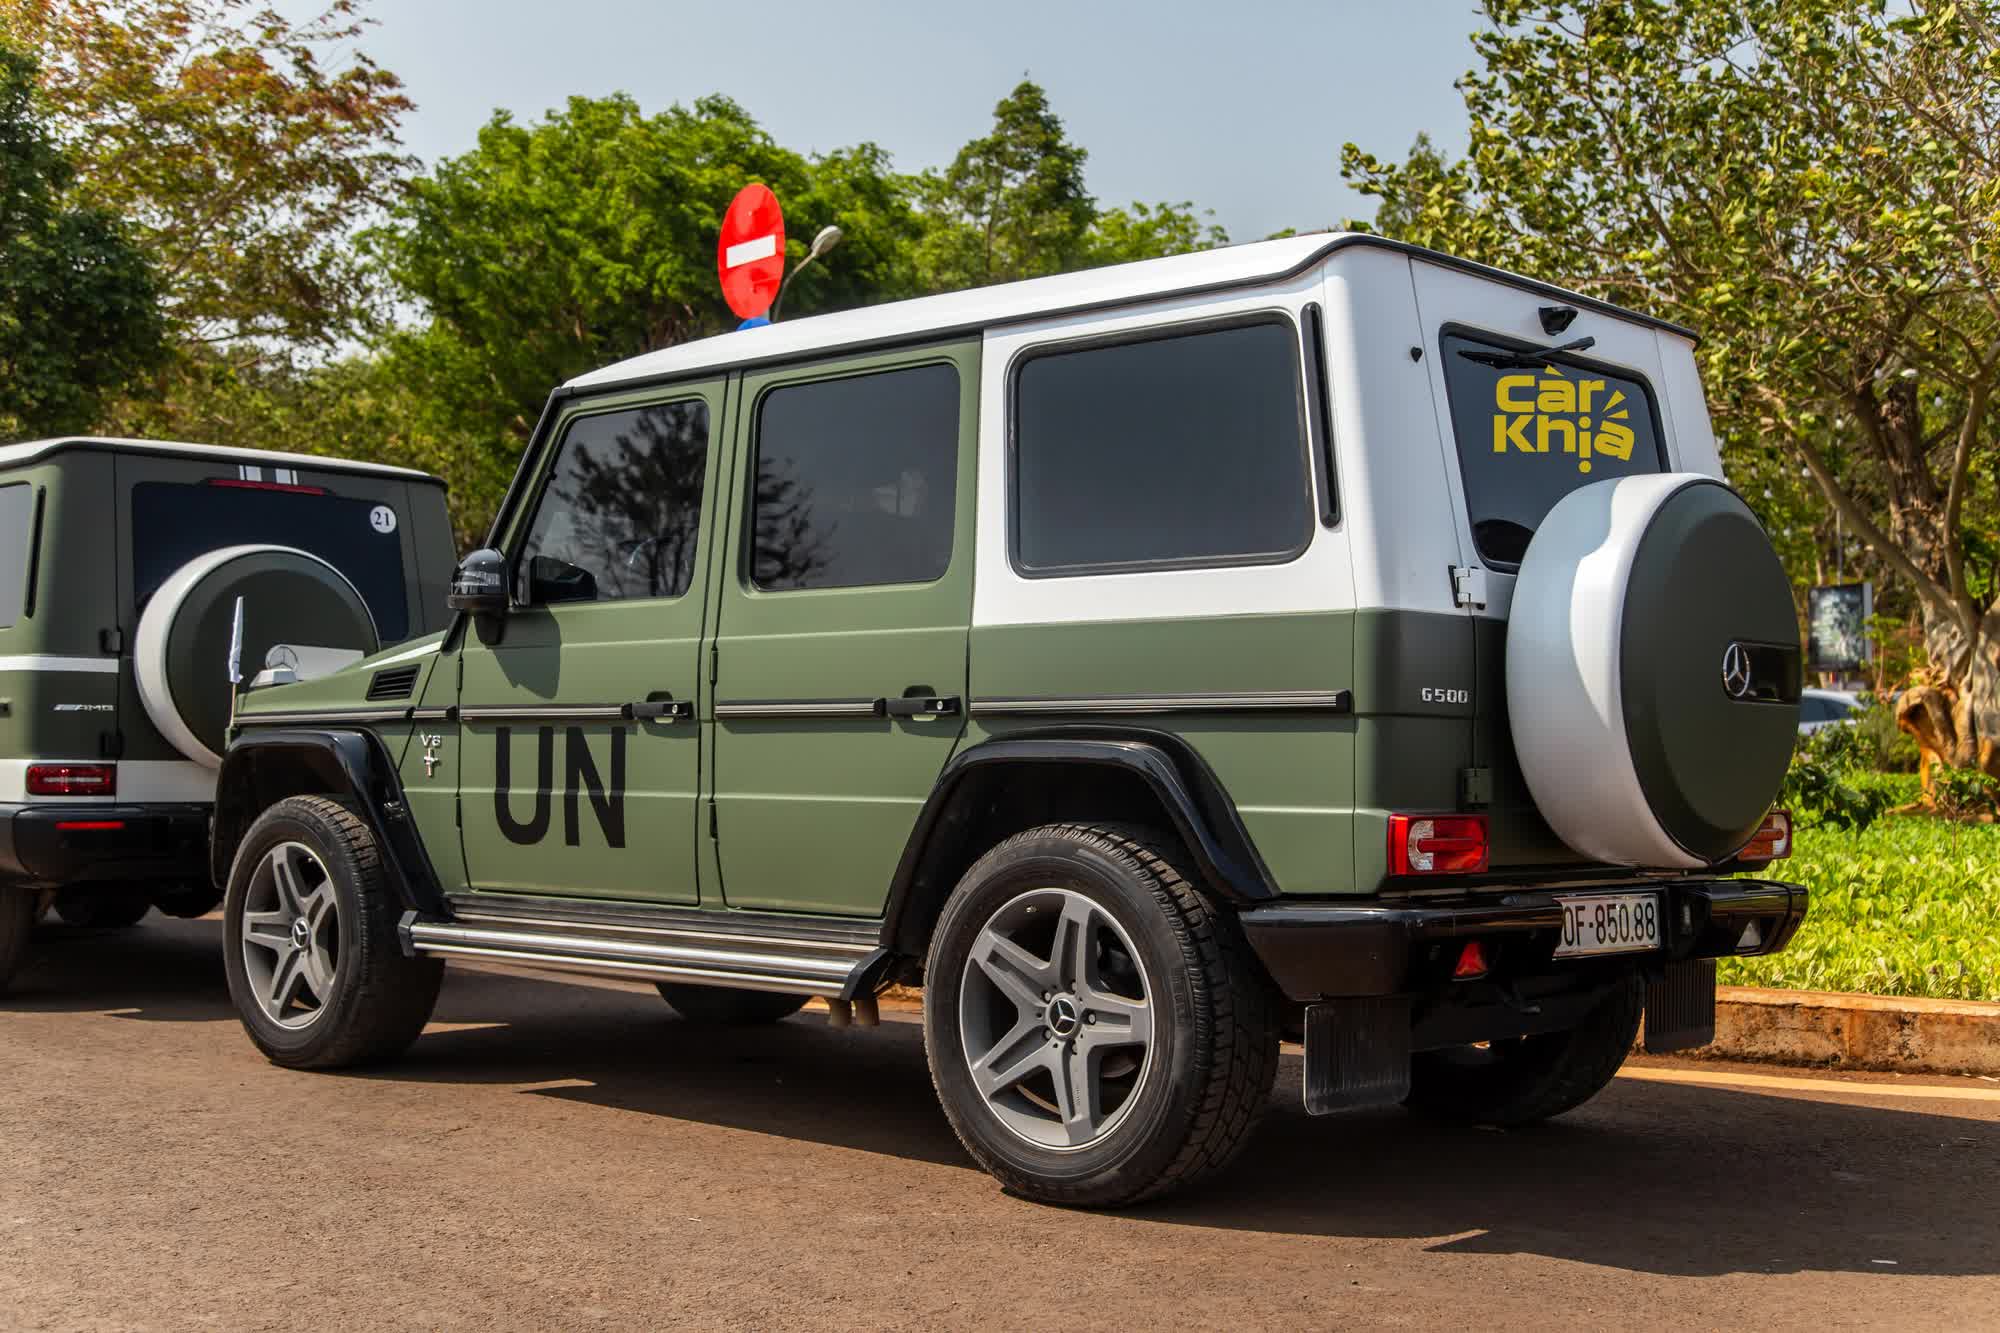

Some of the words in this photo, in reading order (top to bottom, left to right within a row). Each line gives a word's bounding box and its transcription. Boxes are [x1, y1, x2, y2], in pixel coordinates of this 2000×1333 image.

[374, 511, 390, 527] 21
[76, 703, 115, 712] AMG
[495, 726, 626, 849] UN
[1561, 901, 1656, 947] 0F-850.88
